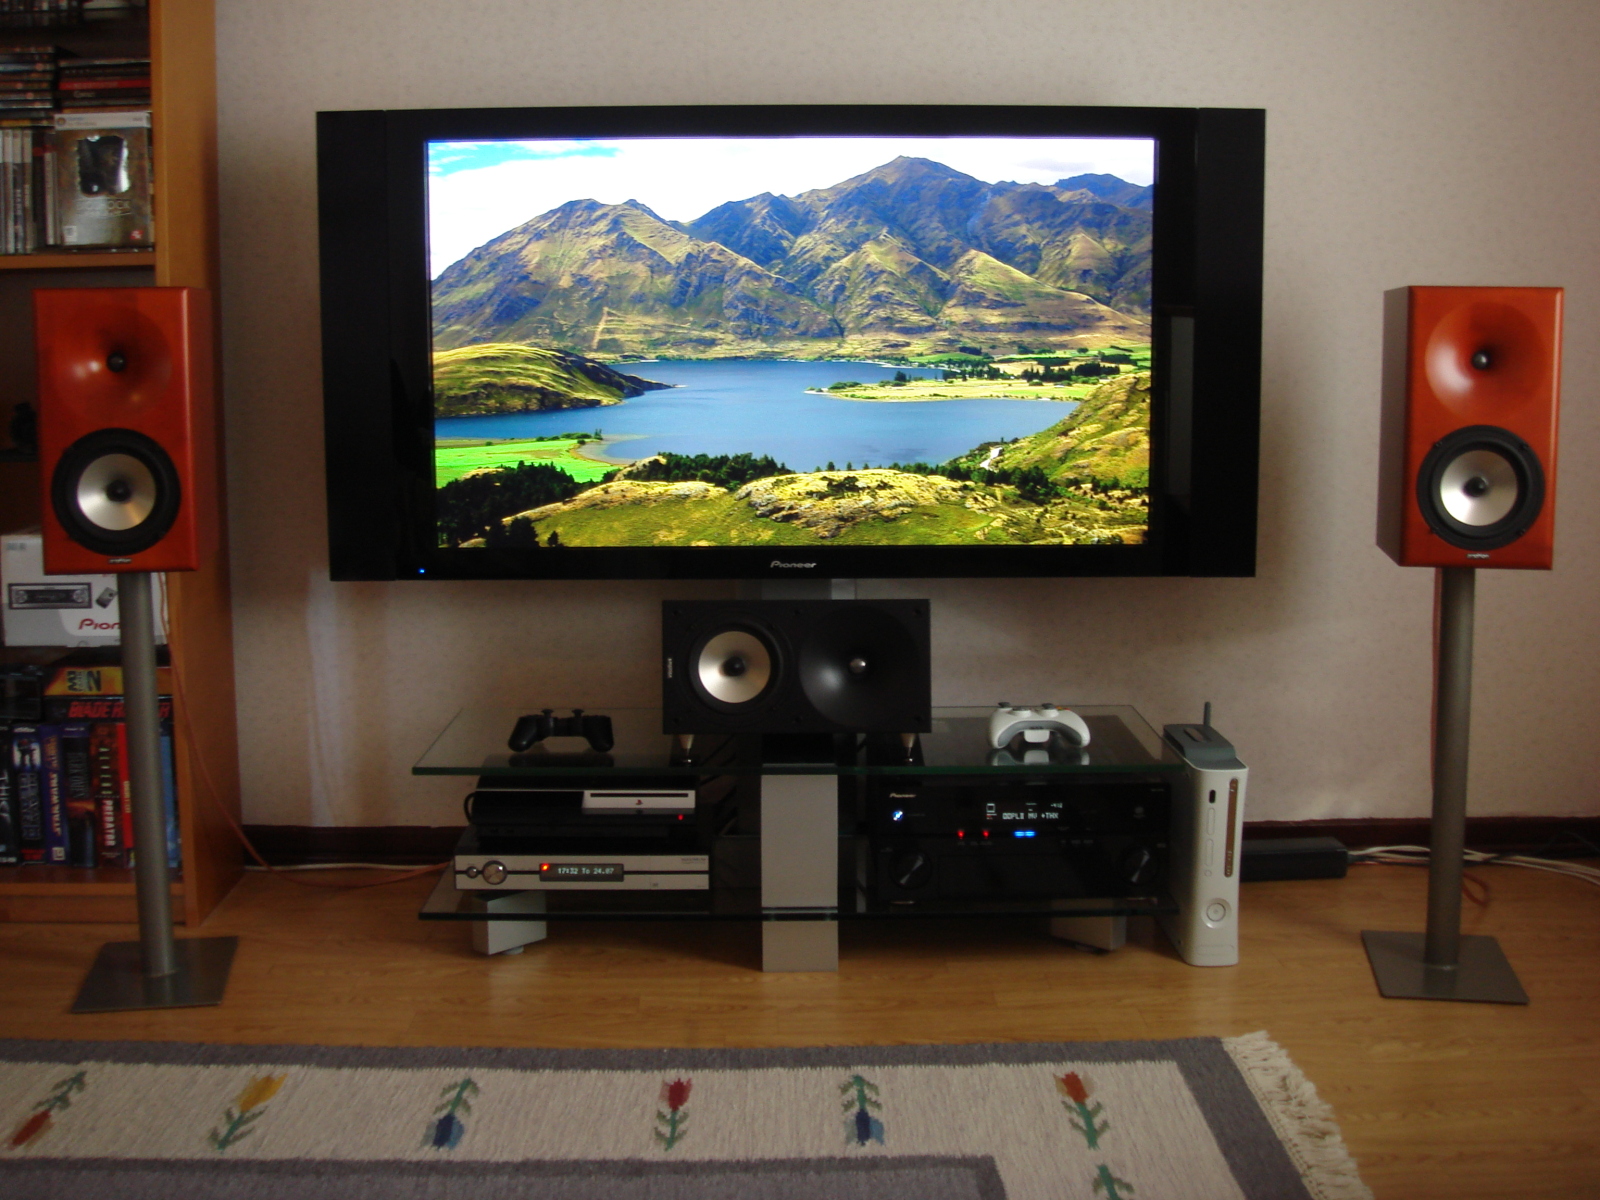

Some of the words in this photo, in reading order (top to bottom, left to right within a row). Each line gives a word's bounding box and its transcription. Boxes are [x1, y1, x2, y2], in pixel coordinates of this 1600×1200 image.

[770, 560, 817, 568] Pioneer
[78, 618, 120, 630] Pion
[68, 702, 111, 718] BLADE
[103, 800, 116, 846] PREDATOR
[557, 867, 579, 875] 17:32
